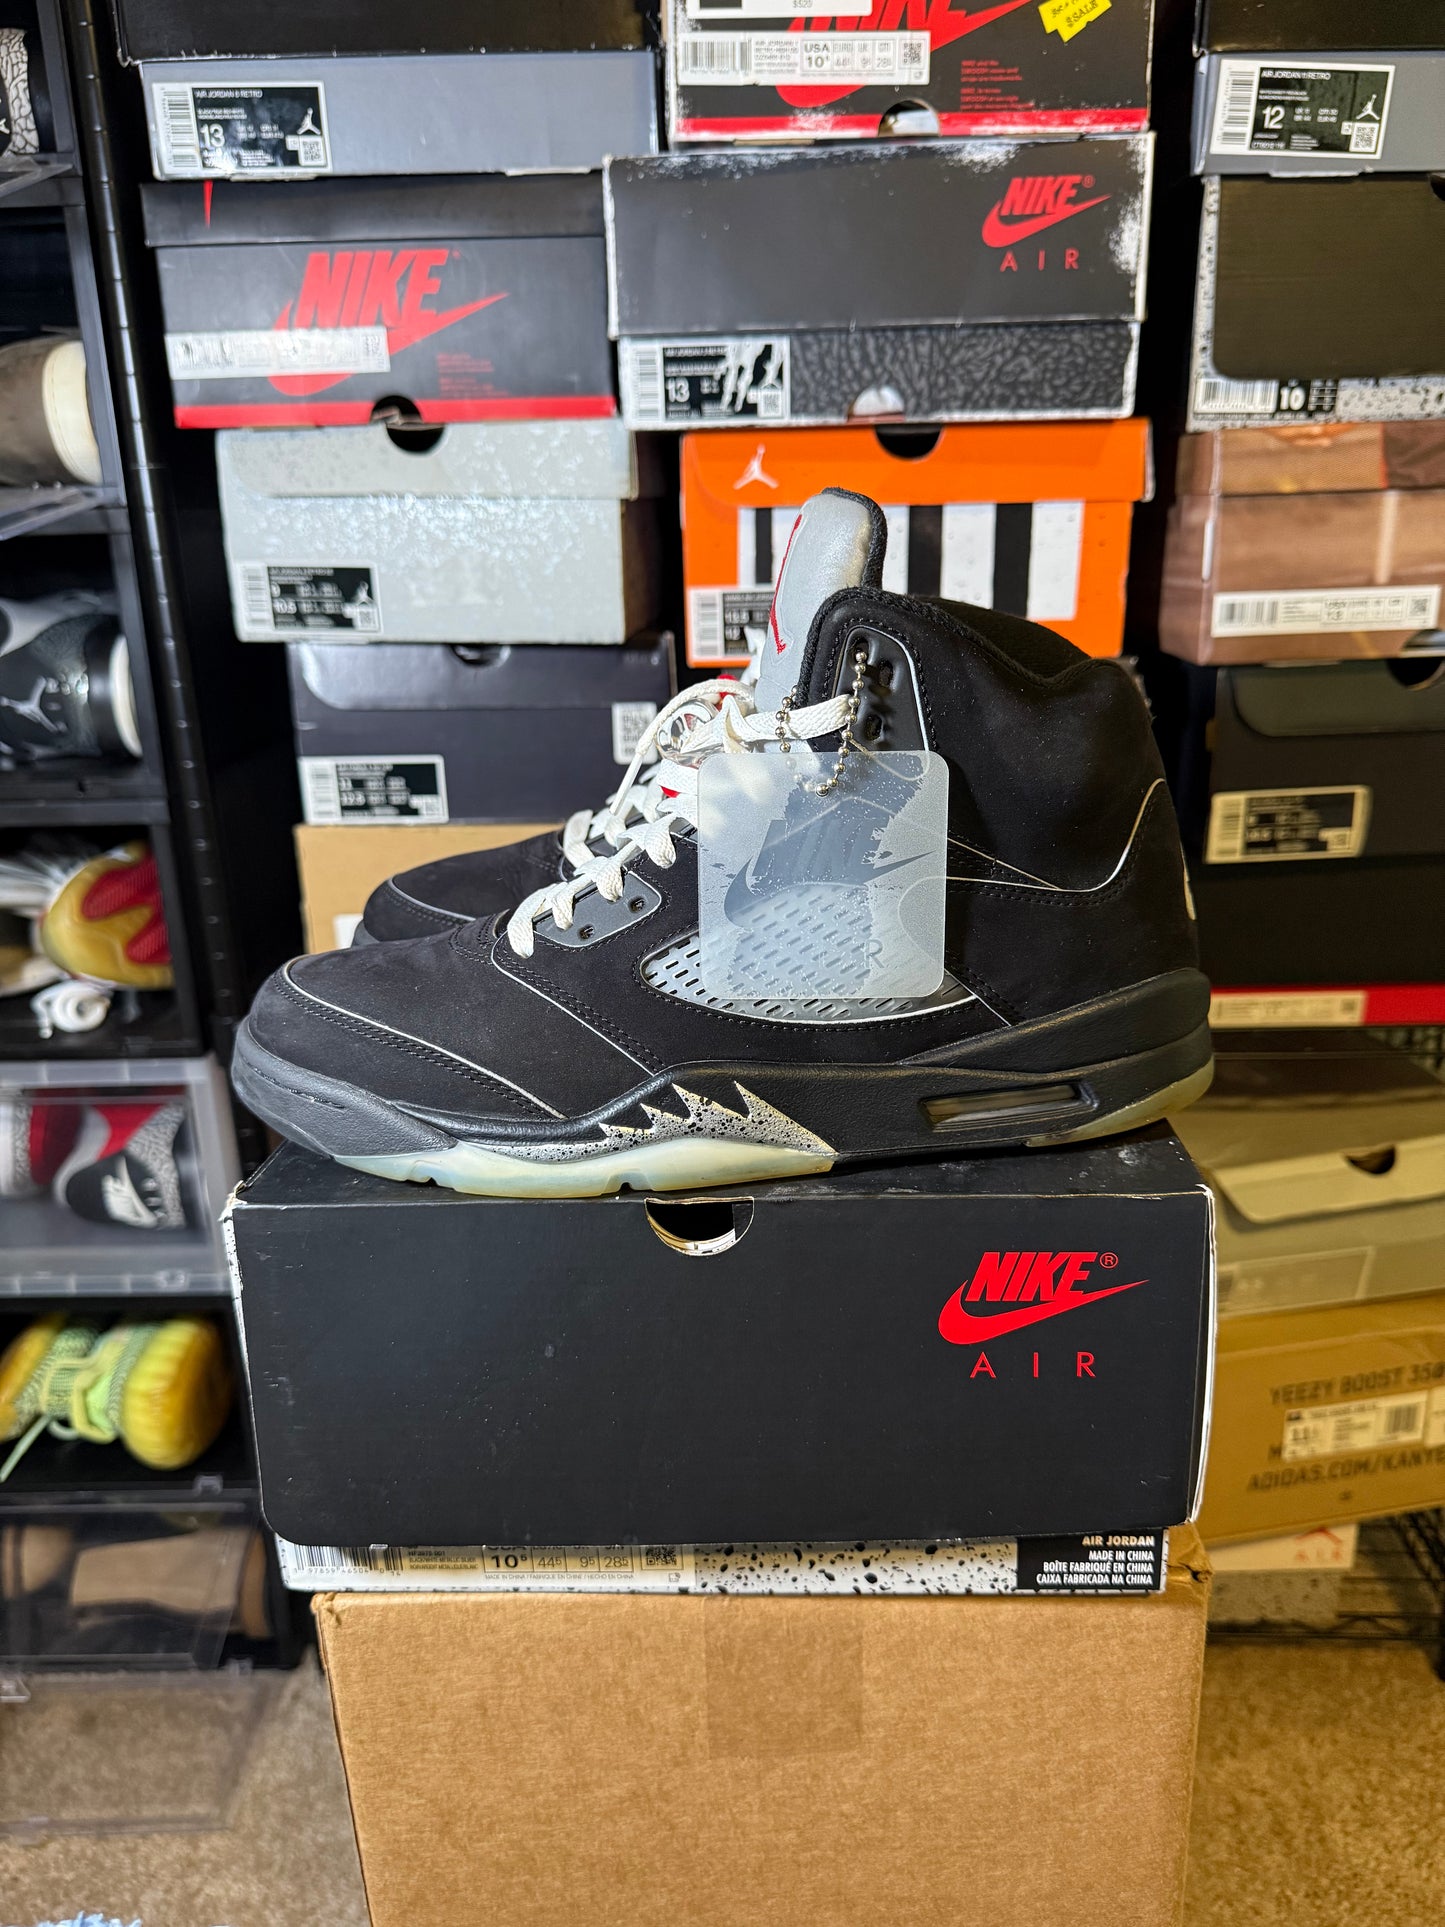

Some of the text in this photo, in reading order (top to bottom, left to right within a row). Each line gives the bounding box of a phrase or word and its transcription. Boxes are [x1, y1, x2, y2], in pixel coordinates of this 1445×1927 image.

[804, 43, 829, 53] USA
[1262, 105, 1285, 129] 12
[200, 123, 226, 149] 13
[1000, 174, 1083, 216] NIKE
[1000, 247, 1080, 272] AIR
[294, 249, 450, 329] NIKE
[666, 377, 691, 403] 13
[1280, 387, 1306, 411] 10
[965, 1251, 1099, 1302] NIKE
[969, 1351, 1096, 1378] AIR
[1270, 1379, 1335, 1405] YEEZY
[1339, 1366, 1404, 1394] BOOST
[1082, 1535, 1155, 1547] AIR JORDAN
[1043, 1560, 1068, 1573] BOÎTE
[1112, 1562, 1124, 1573] EN
[1126, 1562, 1153, 1573] CHINA
[1088, 1550, 1155, 1562] MADE IN CHINA
[1036, 1573, 1153, 1585] CAIXA FABRICADA NA CHINA
